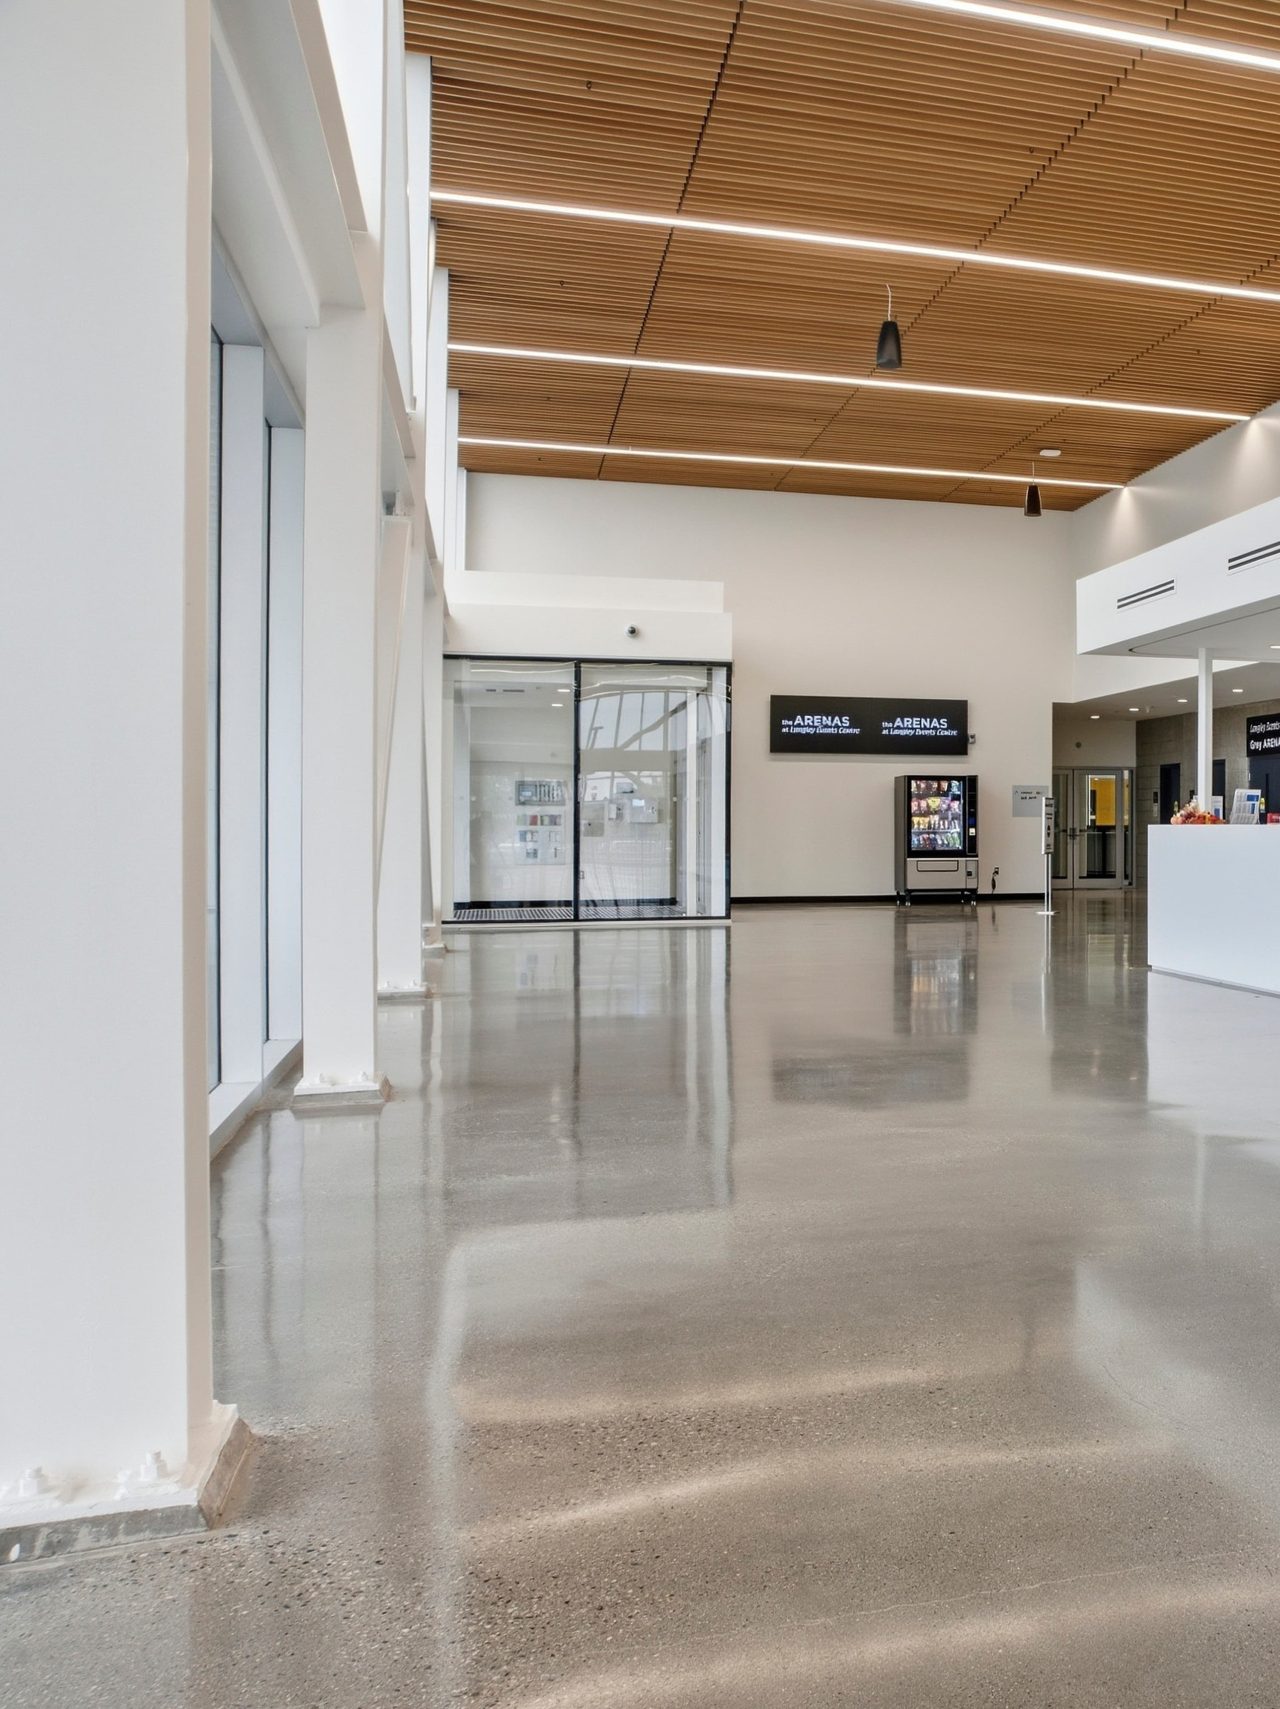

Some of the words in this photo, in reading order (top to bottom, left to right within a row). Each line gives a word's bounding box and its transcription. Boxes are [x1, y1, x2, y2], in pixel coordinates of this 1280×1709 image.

[794, 715, 850, 727] ARENAS
[893, 717, 948, 729] ARENAS
[790, 726, 816, 734] Langley
[890, 728, 915, 736] Langley
[915, 728, 936, 736] Events
[1249, 722, 1266, 734] Langley
